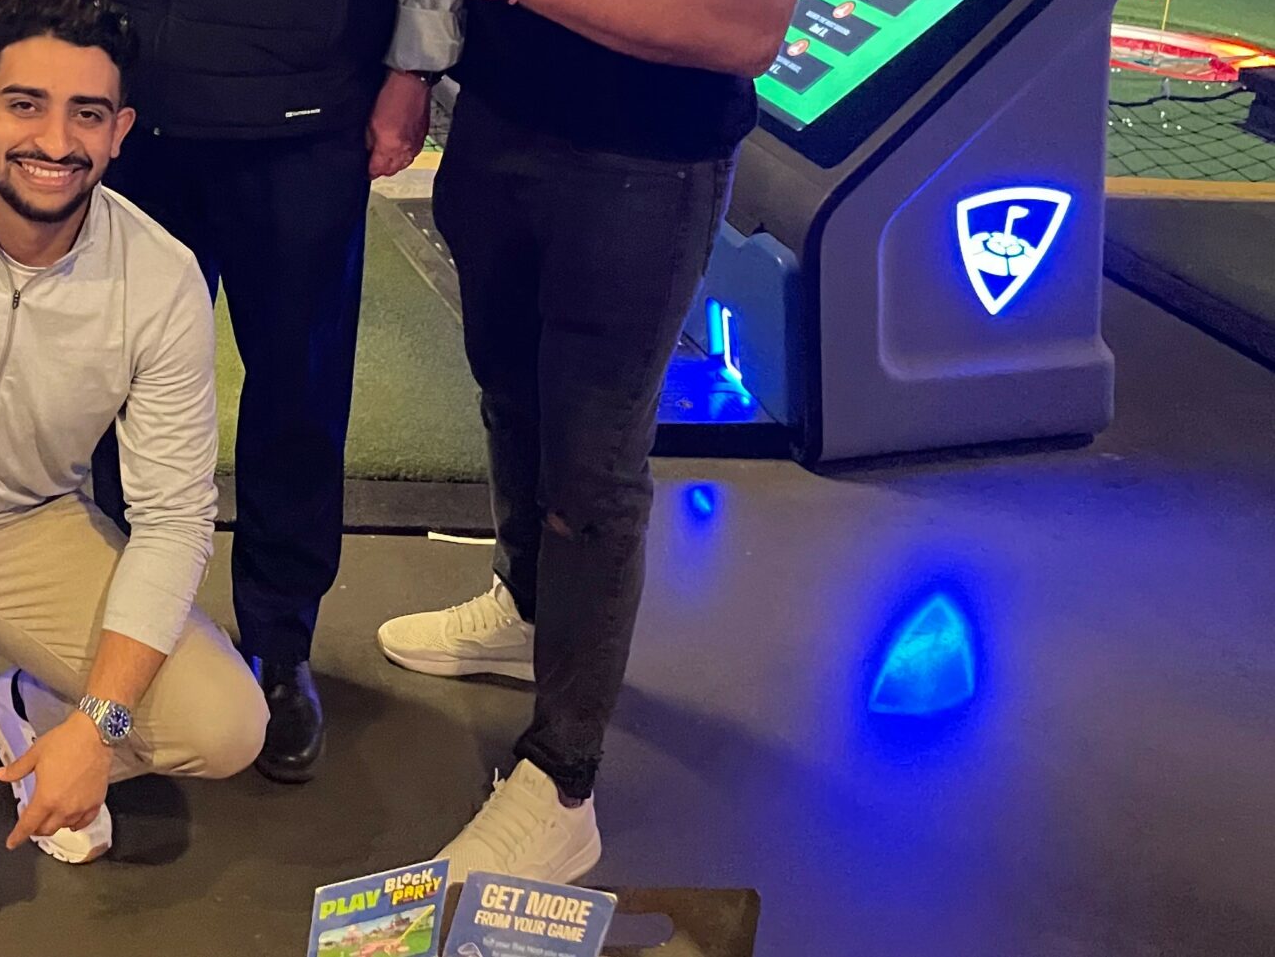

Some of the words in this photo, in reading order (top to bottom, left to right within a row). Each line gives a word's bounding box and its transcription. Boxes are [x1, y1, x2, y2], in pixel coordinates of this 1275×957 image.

[384, 868, 434, 893] BLOCK
[392, 876, 442, 905] PARTY
[319, 888, 381, 920] PLAY
[481, 884, 524, 911] GET
[525, 891, 593, 925] MORE
[474, 910, 511, 929] FROM
[514, 916, 545, 935] YOUR
[547, 923, 586, 943] GAME
